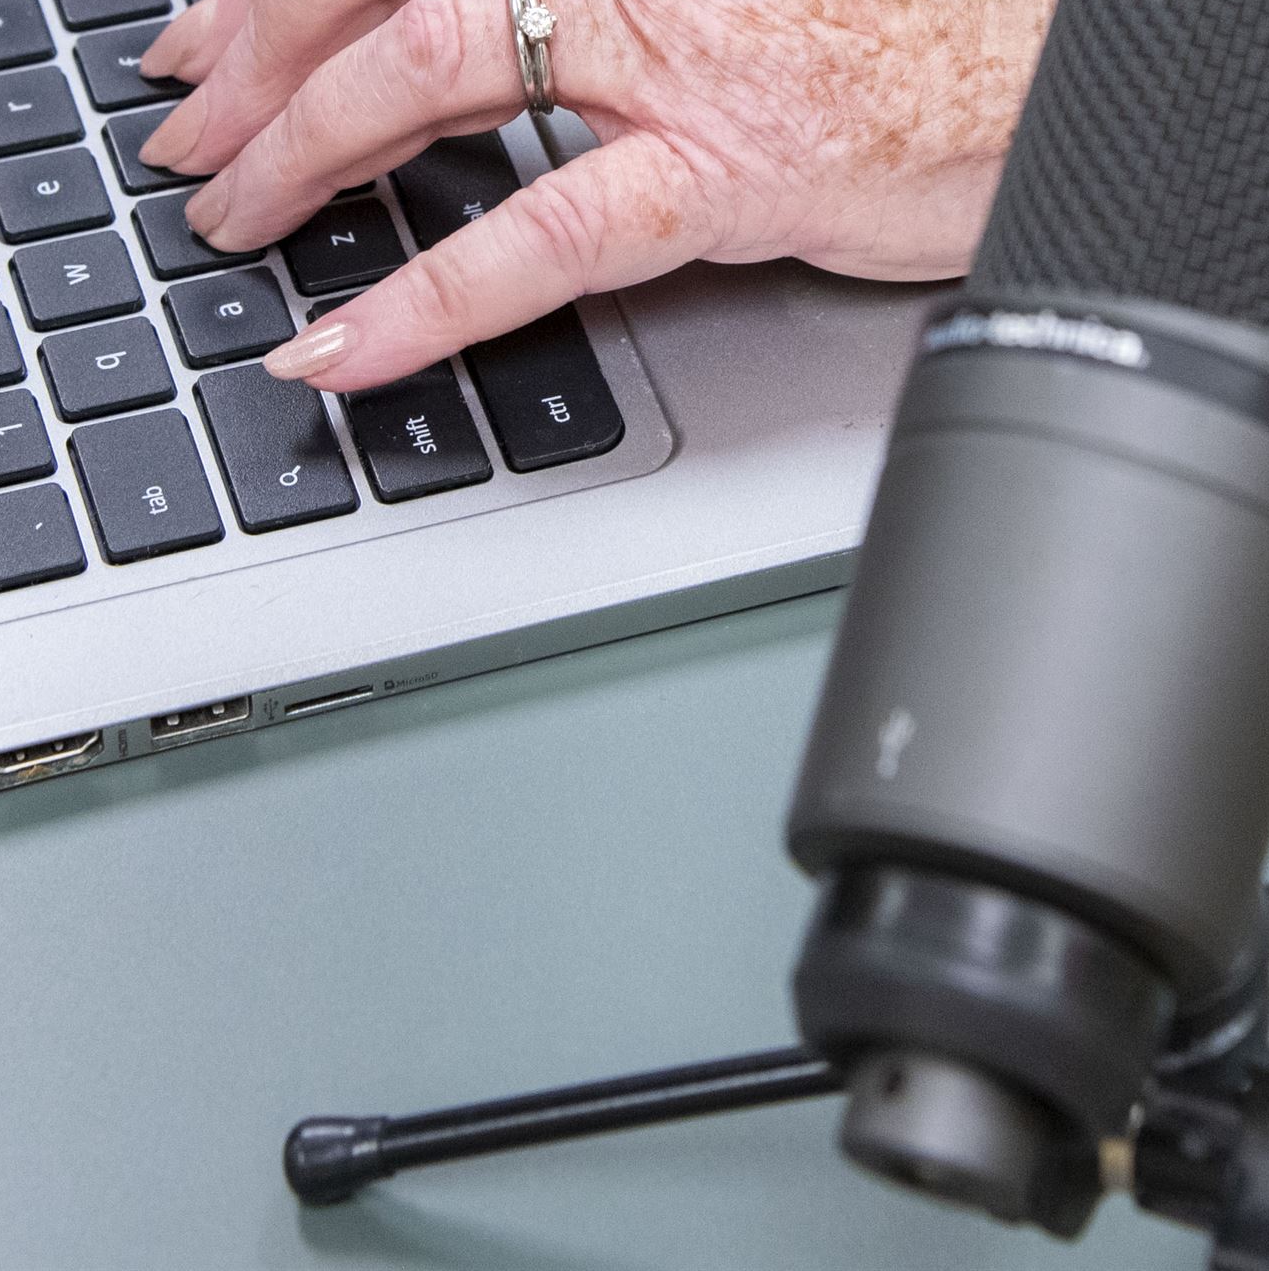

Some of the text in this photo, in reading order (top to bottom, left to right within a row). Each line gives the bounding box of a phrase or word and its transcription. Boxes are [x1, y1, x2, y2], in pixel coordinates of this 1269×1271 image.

[118, 56, 141, 67] f
[8, 102, 31, 111] r
[37, 181, 60, 195] e
[331, 232, 355, 245] z
[64, 265, 90, 285] w
[220, 302, 243, 316] a
[96, 351, 126, 369] q
[542, 395, 570, 422] ctrl
[406, 416, 437, 454] shift
[142, 486, 168, 514] tab
